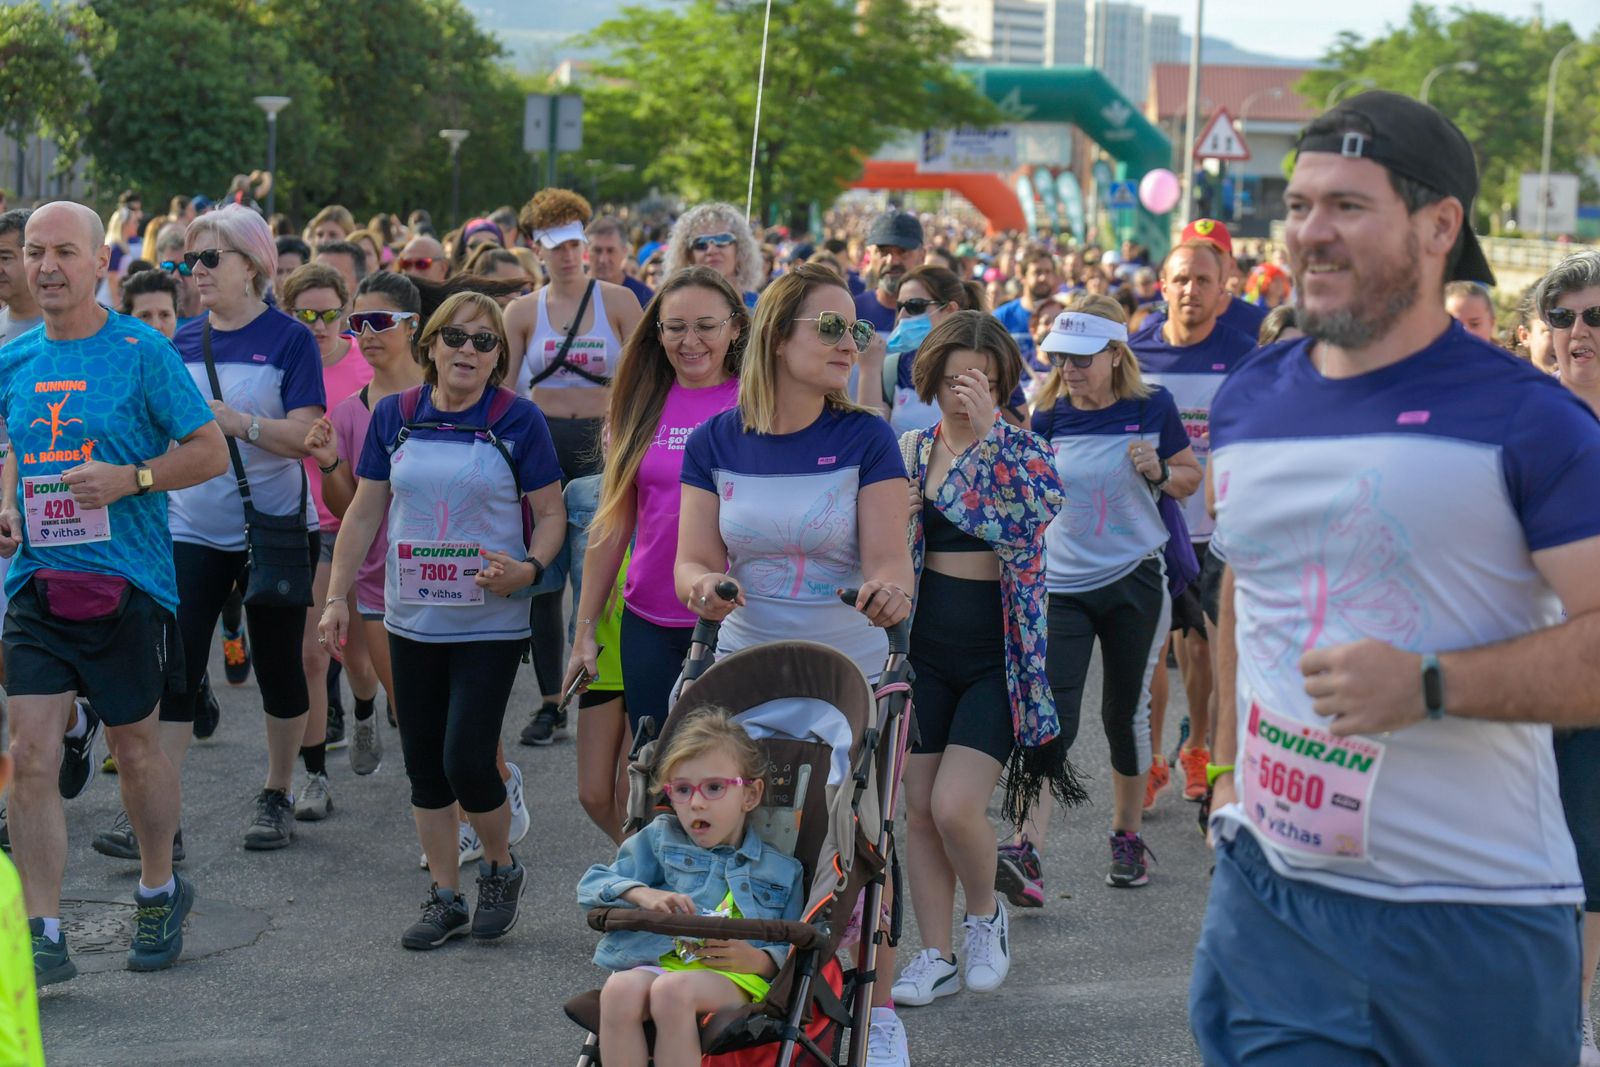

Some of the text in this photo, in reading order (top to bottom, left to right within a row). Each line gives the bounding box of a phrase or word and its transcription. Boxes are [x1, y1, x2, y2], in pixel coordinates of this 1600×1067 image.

[556, 341, 604, 349] CIRAN
[35, 380, 87, 393] RUNNING
[23, 451, 37, 465] AL
[39, 450, 81, 463] BORDE
[44, 498, 75, 519] 420
[52, 528, 86, 538] vithas
[412, 547, 480, 558] COVIRAN
[419, 563, 458, 581] 7302
[431, 589, 462, 599] vithas
[1258, 718, 1375, 773] COVIRAN
[1259, 753, 1325, 811] 5660
[1267, 815, 1322, 846] vithas
